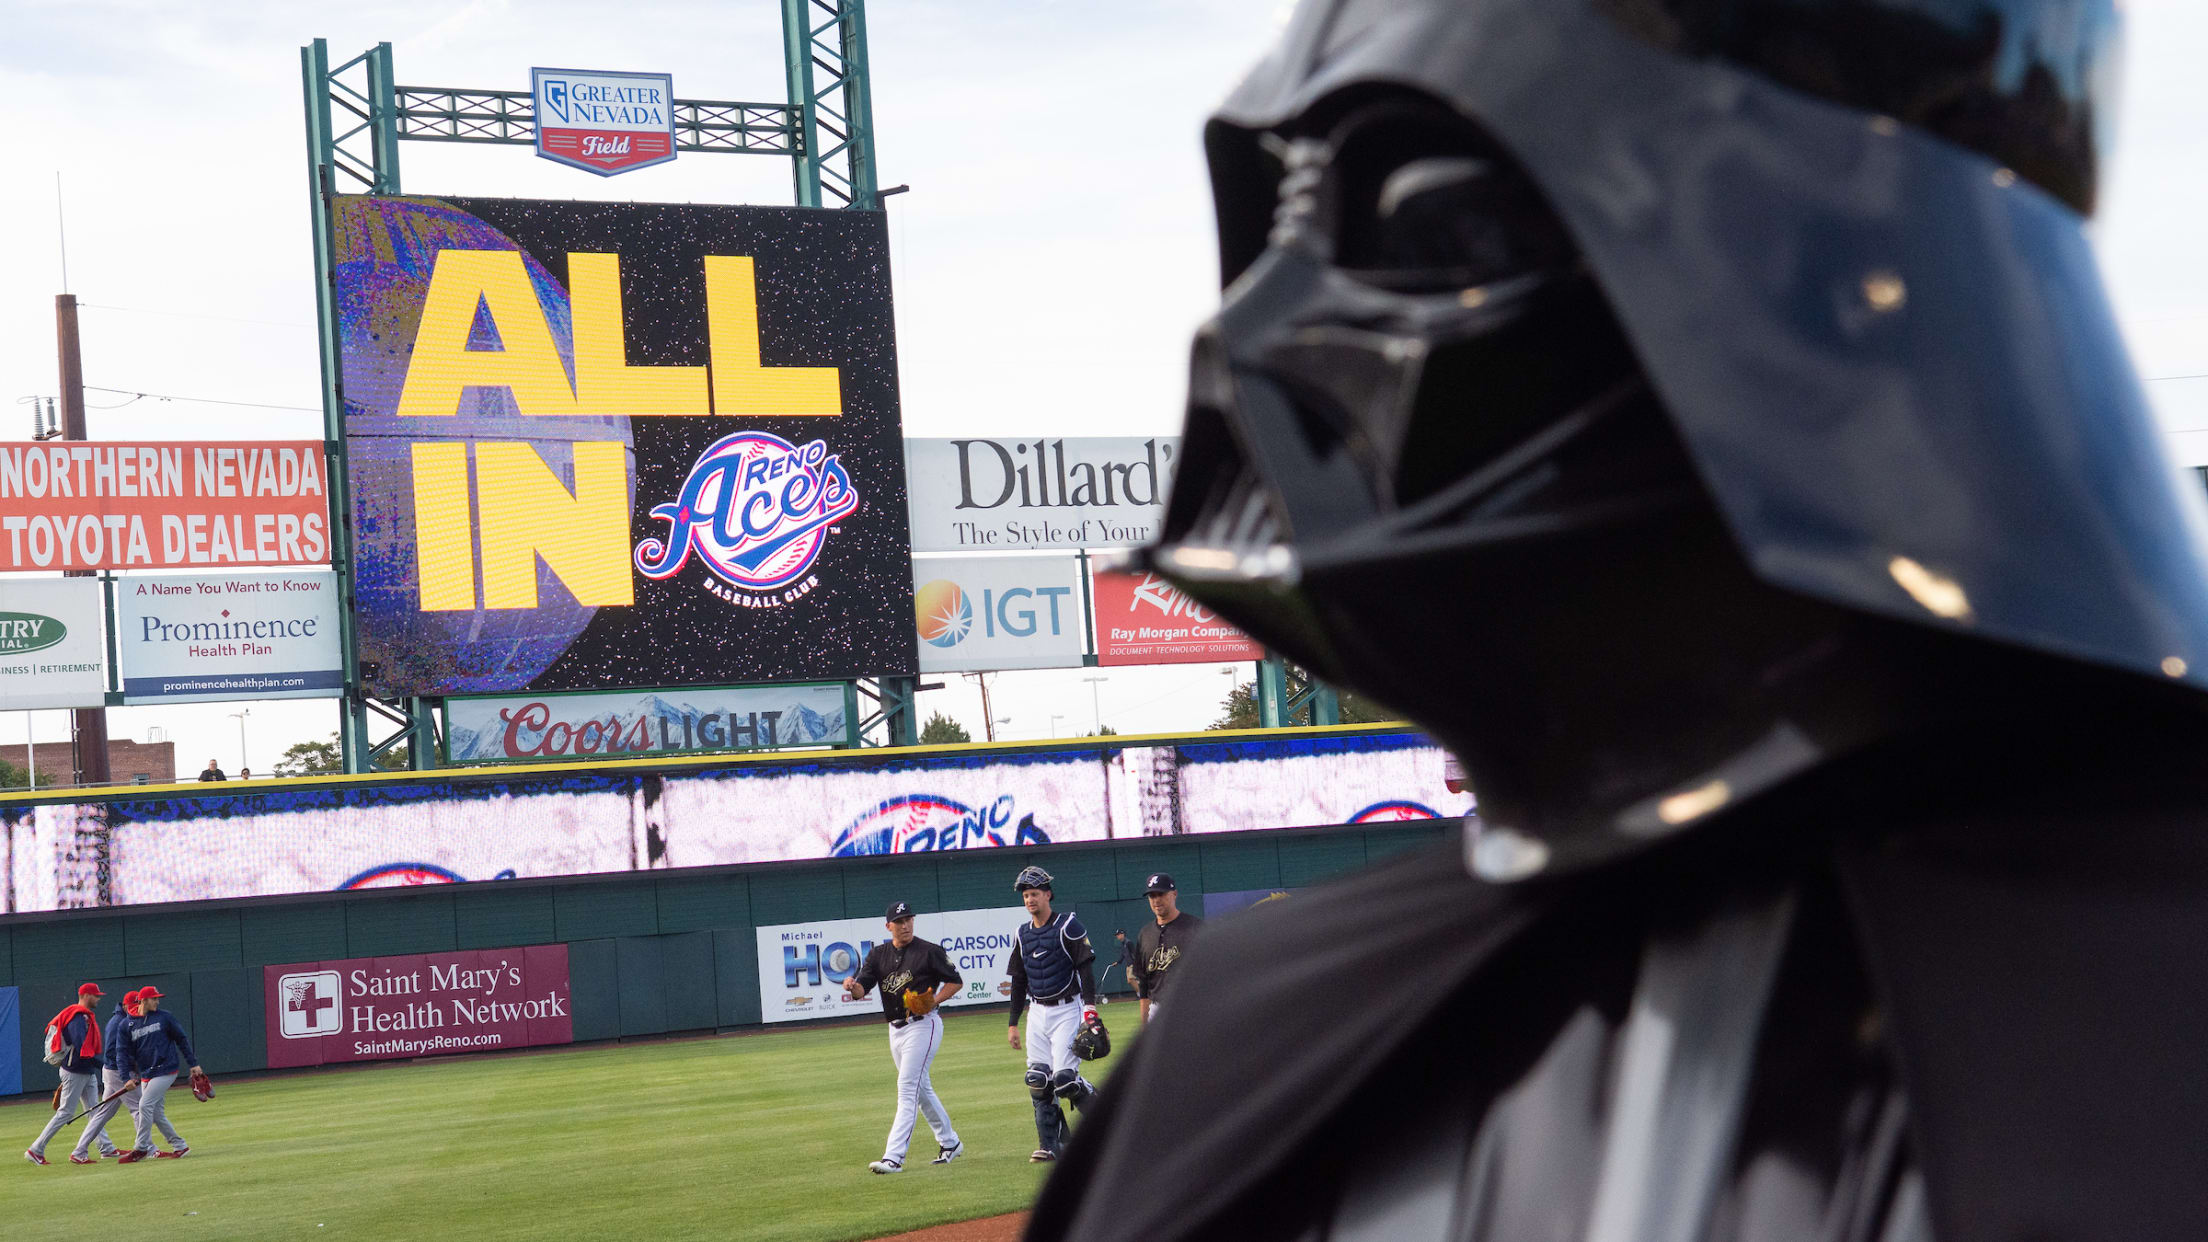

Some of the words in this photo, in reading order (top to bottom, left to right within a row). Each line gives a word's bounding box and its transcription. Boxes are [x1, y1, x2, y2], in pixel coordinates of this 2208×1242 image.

[571, 83, 661, 104] GREATER
[572, 103, 662, 124] NEVADA
[582, 136, 630, 156] Field
[396, 249, 842, 416] ALL
[0, 446, 183, 498] NORTHERN
[195, 447, 322, 497] NEVADA
[744, 440, 826, 491] RENO
[411, 441, 634, 611] IN
[635, 454, 859, 580] Aces
[3, 514, 152, 567] TOYOTA
[162, 513, 325, 564] DEALERS
[953, 522, 998, 545] The
[1007, 520, 1062, 549] Style
[1068, 518, 1089, 542] of
[1098, 520, 1149, 542] Your
[136, 584, 147, 596] A
[152, 583, 192, 595] Name
[196, 582, 221, 594] You
[225, 581, 260, 593] Want
[265, 581, 279, 592] to
[283, 580, 321, 592] Know
[703, 576, 781, 609] BASEBALL
[784, 575, 819, 603] CLUB
[983, 586, 1071, 639] IGT
[140, 611, 317, 642] Prominence
[1110, 627, 1136, 642] Ray
[1138, 627, 1188, 641] Morgan
[189, 643, 237, 658] Health
[242, 643, 272, 656] Plan
[1109, 646, 1152, 656] DOCUMENT
[1156, 645, 1205, 654] TECHNOLOGY
[1208, 644, 1249, 653] SOLUTIONS
[0, 666, 29, 675] INESS
[40, 663, 101, 673] RETIREMENT
[163, 677, 305, 693] prominencehealthplan.com
[500, 702, 654, 758] Coors
[659, 710, 783, 750] LIGHT
[781, 931, 823, 941] Michael
[941, 934, 1011, 952] CARSON
[960, 954, 995, 969] CITY
[350, 968, 421, 997] Saint
[429, 960, 521, 996] Mary's
[972, 982, 985, 991] RV
[967, 991, 991, 999] Center
[351, 1001, 444, 1033] Health
[452, 991, 567, 1026] Network
[354, 1033, 501, 1055] SaintMarysReno.com
